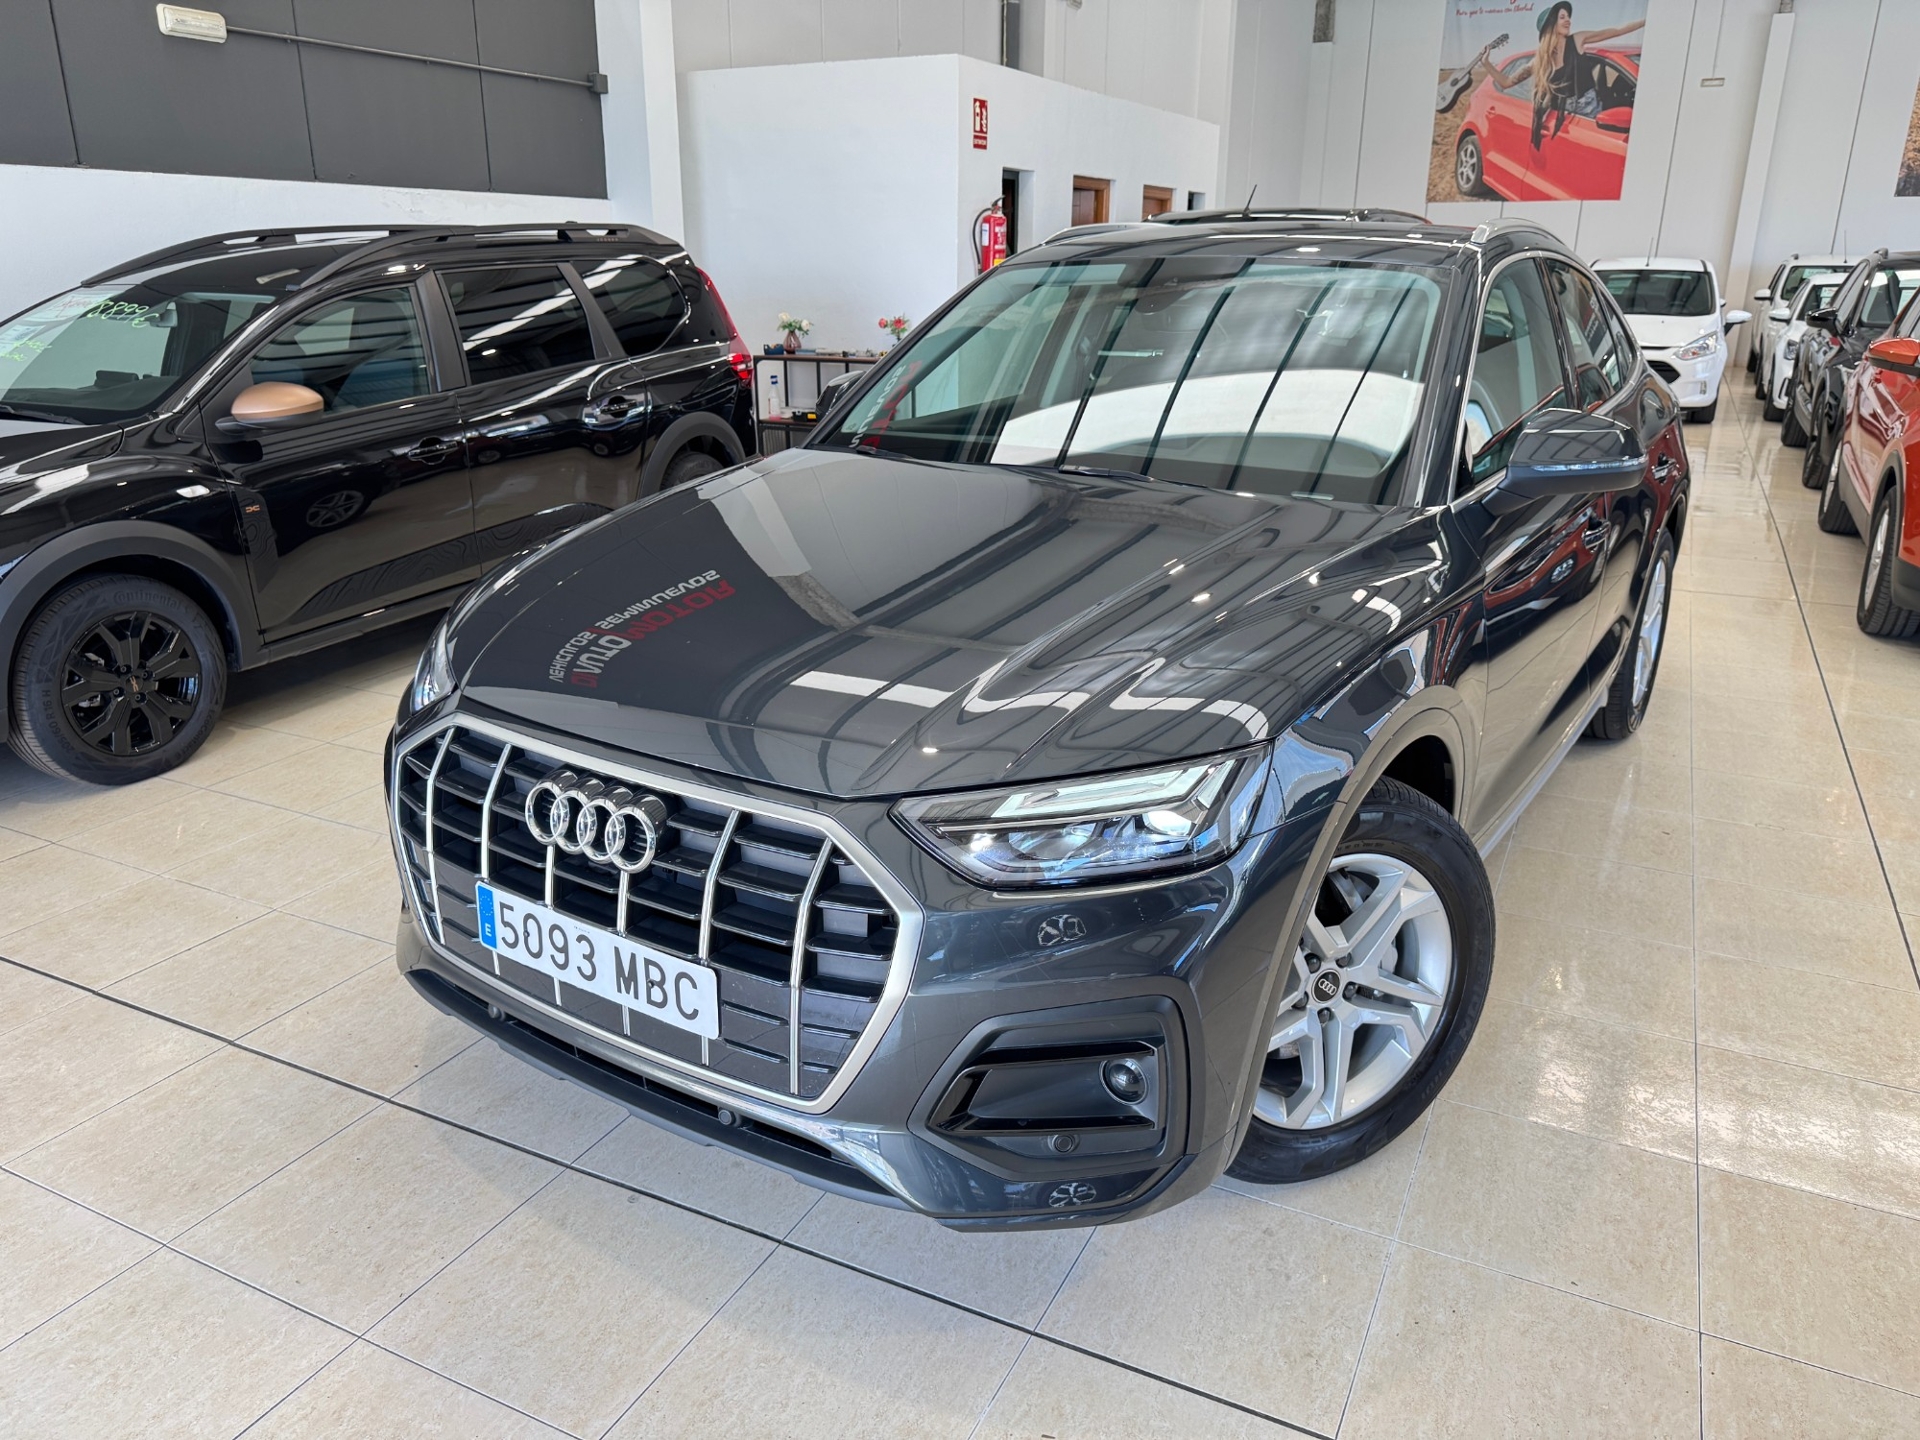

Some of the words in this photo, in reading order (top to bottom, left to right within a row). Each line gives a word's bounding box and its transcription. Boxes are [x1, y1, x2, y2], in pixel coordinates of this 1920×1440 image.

[114, 590, 181, 609] Continental
[485, 922, 492, 937] E
[499, 901, 597, 982] 5093
[614, 946, 699, 1021] MBC
